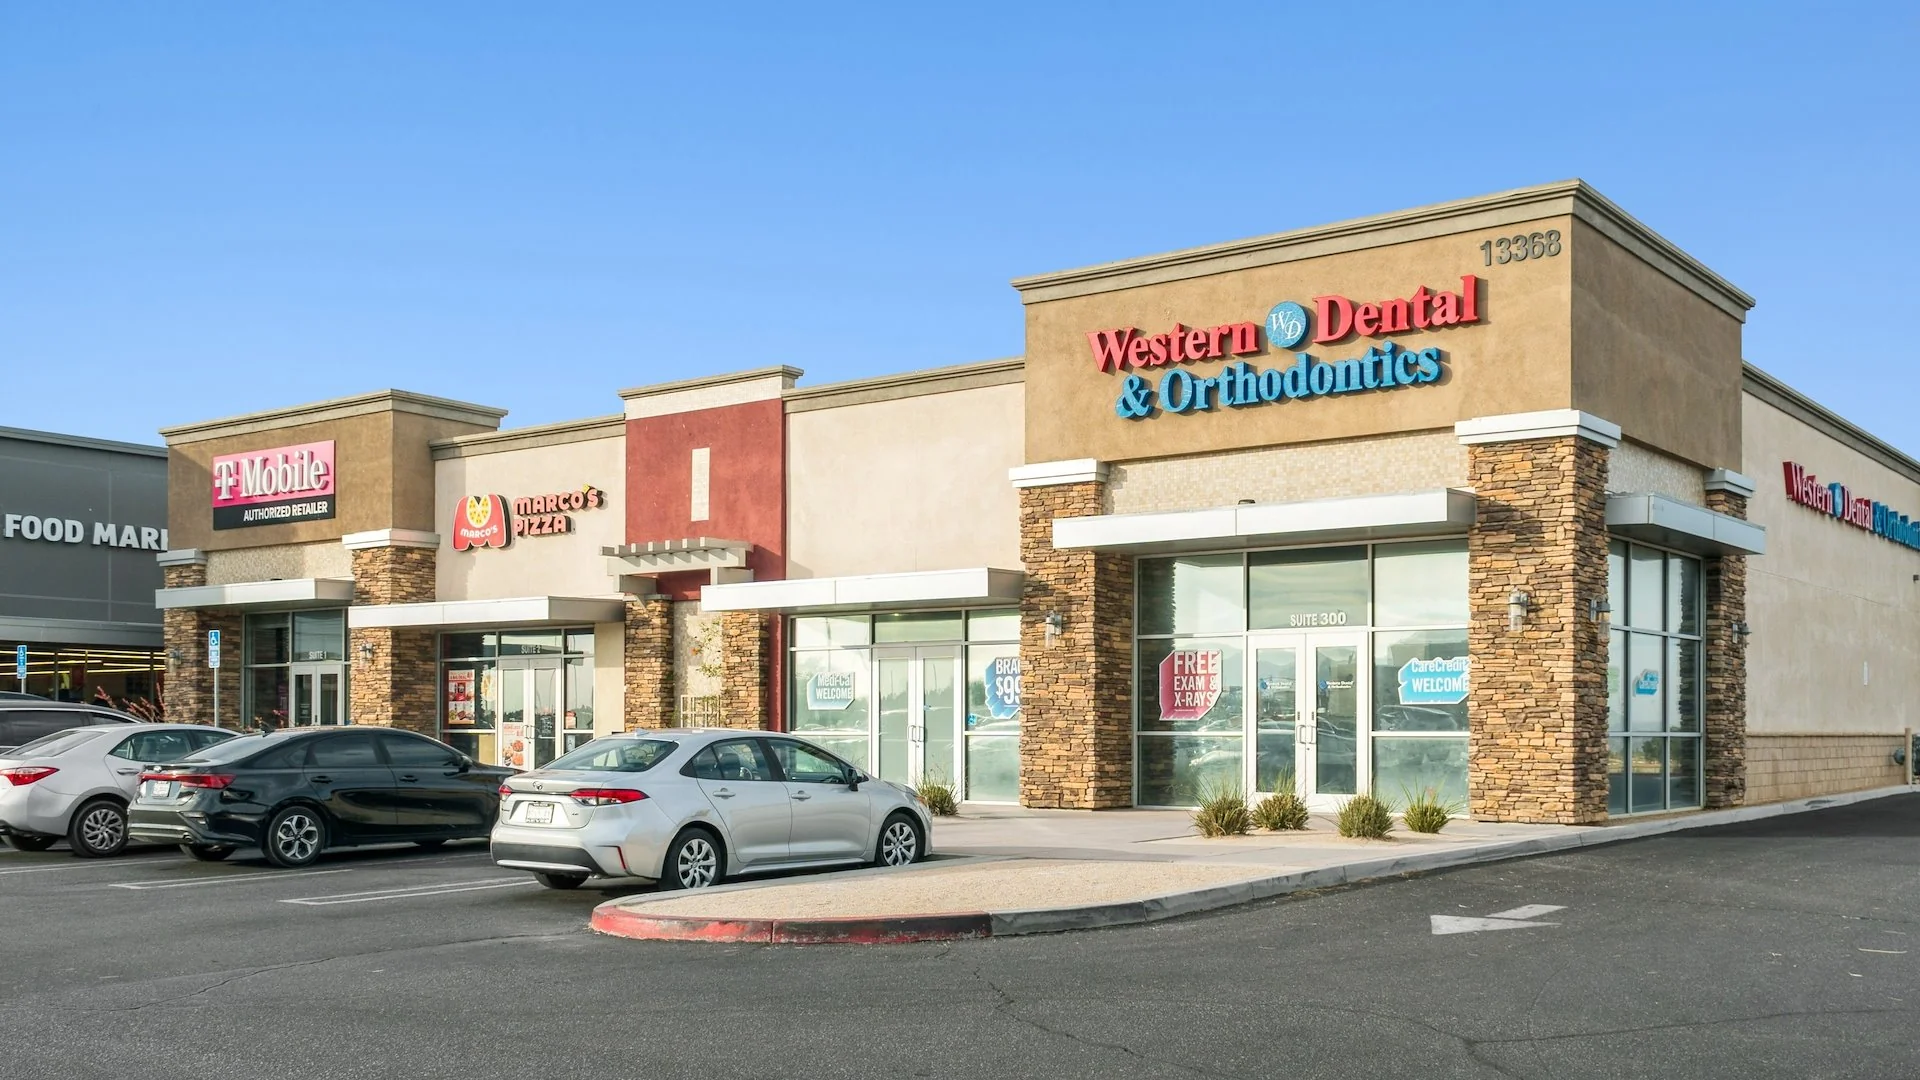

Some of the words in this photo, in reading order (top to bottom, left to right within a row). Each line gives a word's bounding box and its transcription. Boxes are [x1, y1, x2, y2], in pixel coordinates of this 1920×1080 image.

[1480, 230, 1561, 266] 13368
[1085, 321, 1259, 373] Western
[1271, 310, 1303, 341] WD
[1312, 275, 1481, 343] Dental
[1115, 374, 1154, 419] &
[1158, 340, 1443, 413] Orthodontics
[514, 484, 600, 516] MARCO'S
[1784, 462, 1833, 515] Western
[1842, 486, 1873, 531] Dental
[243, 505, 291, 521] AUTHORIZED
[292, 501, 328, 516] RETAILER
[5, 514, 84, 543] FOOD
[460, 525, 498, 538] MARCO'S
[514, 515, 568, 536] PIZZA
[1290, 613, 1318, 626] SUITE
[1320, 611, 1347, 625] 300
[309, 651, 324, 659] SUITE
[520, 644, 536, 654] SUITE
[1174, 651, 1219, 674] FREE
[1411, 659, 1467, 673] CareCredit
[1174, 675, 1205, 690] EXAM
[1209, 675, 1218, 690] &
[1411, 677, 1469, 693] WELCOME
[815, 687, 852, 700] WELCOME
[1174, 691, 1215, 706] X-RAYS
